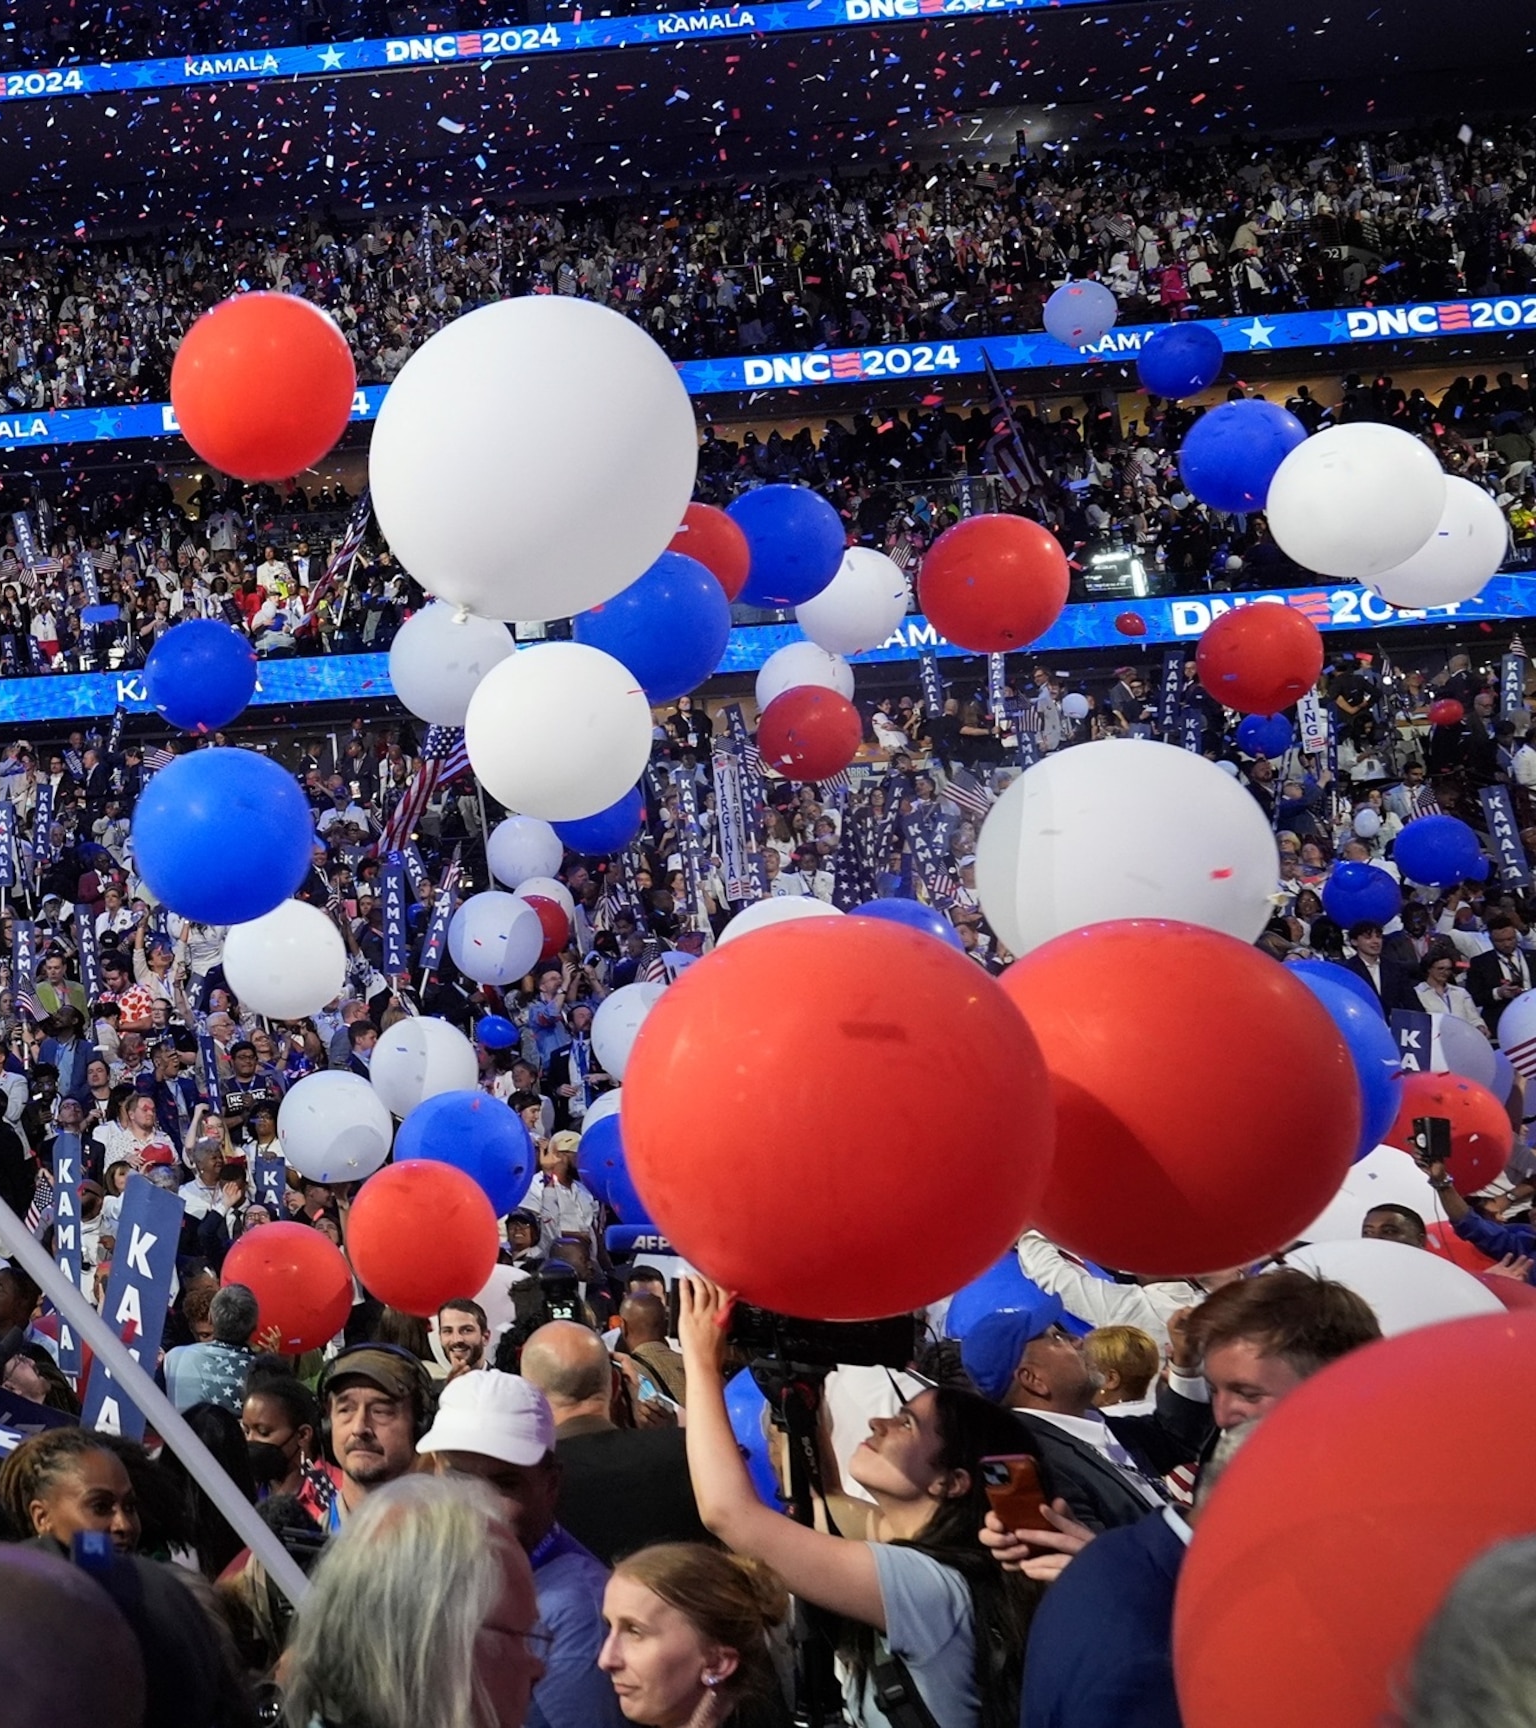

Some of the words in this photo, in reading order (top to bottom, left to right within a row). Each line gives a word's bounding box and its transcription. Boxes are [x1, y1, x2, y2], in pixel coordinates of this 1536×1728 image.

[657, 10, 755, 35] KAMALA
[845, 0, 917, 21] DNC
[184, 53, 278, 77] KAMALA
[386, 36, 455, 63] DNC
[482, 25, 561, 54] 2024
[7, 69, 83, 96] 2024
[1347, 306, 1438, 338] DNC
[745, 353, 830, 386] DNC
[862, 345, 960, 379] 2024
[17, 517, 35, 564] KAMALA
[876, 623, 948, 649] AM
[1172, 596, 1284, 636] DN
[1331, 588, 1461, 624] 20
[922, 657, 939, 712] KAMALA
[1163, 659, 1179, 725] KAMALA
[35, 791, 48, 854] KAMALA
[680, 779, 699, 848] KAMAA
[716, 771, 737, 879] VIRGINIA
[1489, 798, 1523, 878] KAMALA
[386, 876, 401, 966] KAMALA
[425, 891, 451, 960] AMALA
[59, 1158, 75, 1352] KAMAA
[95, 1223, 158, 1437] KAA
